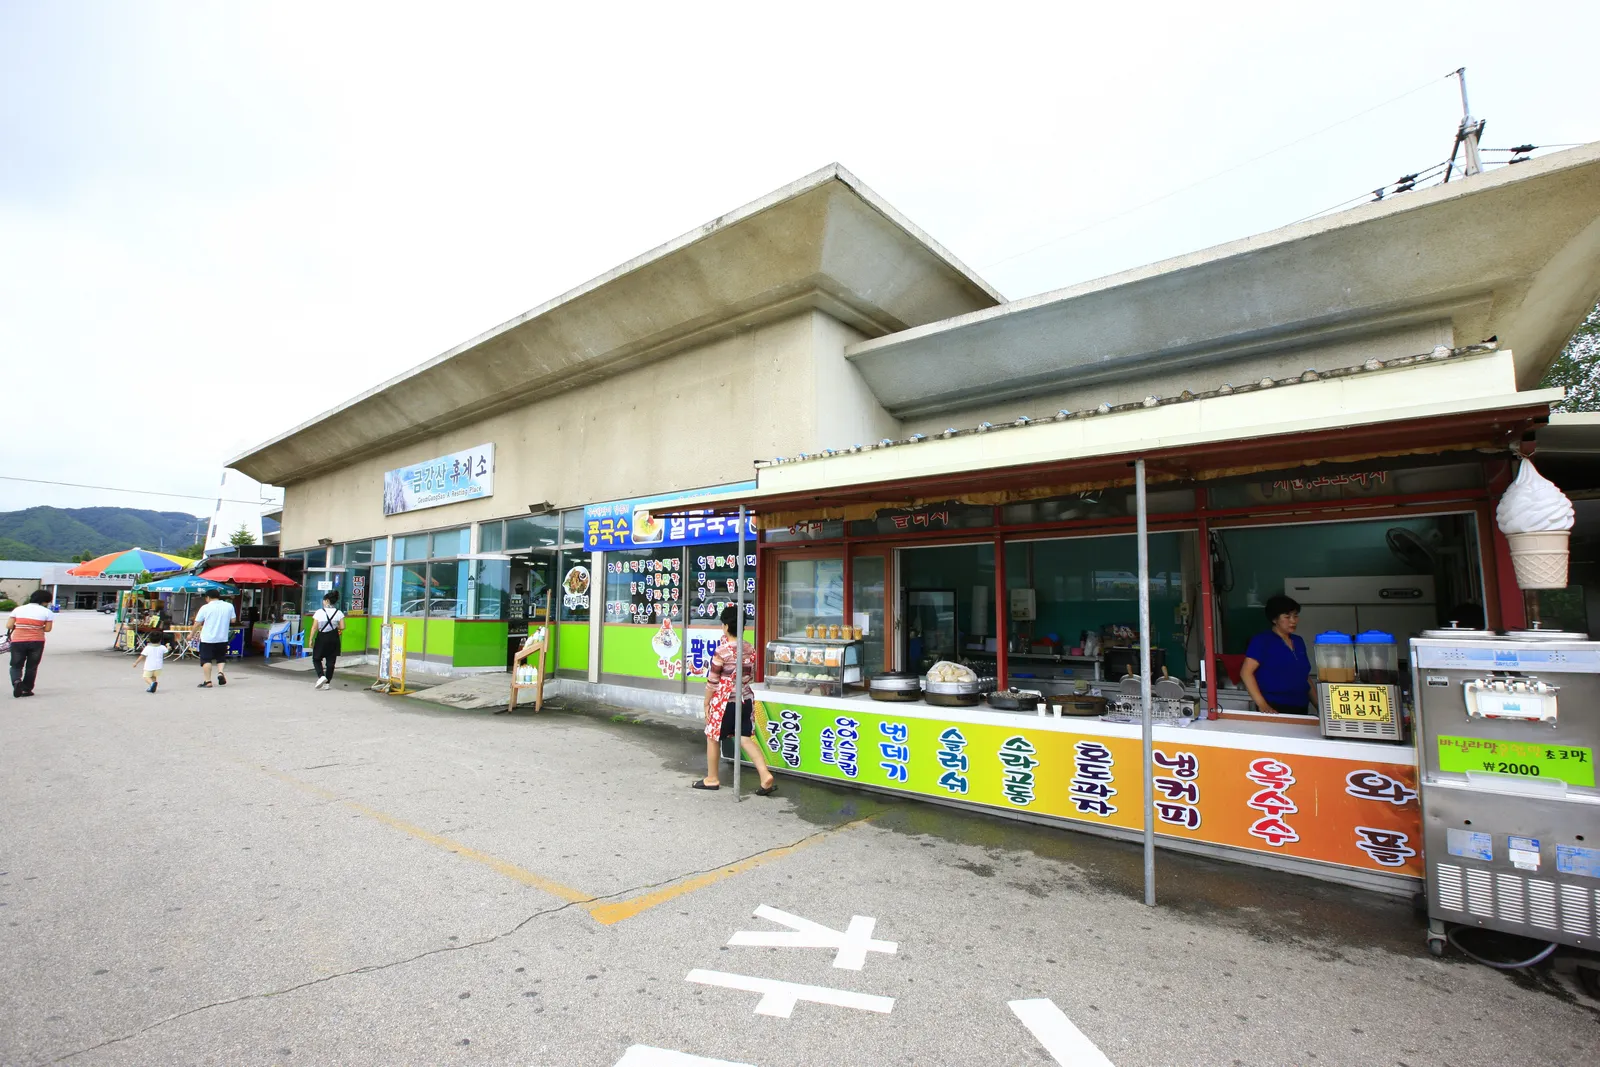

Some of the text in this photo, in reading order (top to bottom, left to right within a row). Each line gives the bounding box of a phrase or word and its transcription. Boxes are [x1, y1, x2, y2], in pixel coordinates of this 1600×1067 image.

[412, 455, 487, 494] 금강산 휴게소
[469, 486, 482, 494] Place
[588, 516, 630, 546] 콩국수
[352, 576, 365, 611] 편의점
[629, 560, 638, 614] 떡볶이
[638, 559, 646, 615] 콩국수
[646, 559, 654, 616] 잔치국수
[657, 658, 683, 680] 팥빙수
[1338, 690, 1381, 703] 냉커피
[1339, 704, 1383, 717] 매실차
[766, 720, 782, 753] 구슬
[779, 709, 802, 768] 아이스크림
[819, 727, 837, 765] 소프트
[835, 715, 860, 778] 아이스크림
[878, 720, 909, 784] 번데기
[1439, 738, 1498, 755] 바닐라맛
[1545, 749, 1588, 763] 초코맛
[998, 735, 1039, 807] 소라고동
[1068, 739, 1118, 818] 호도과자
[1151, 748, 1202, 831] 냉커피
[1246, 757, 1301, 848] 옥수수
[1345, 768, 1418, 869] 와플
